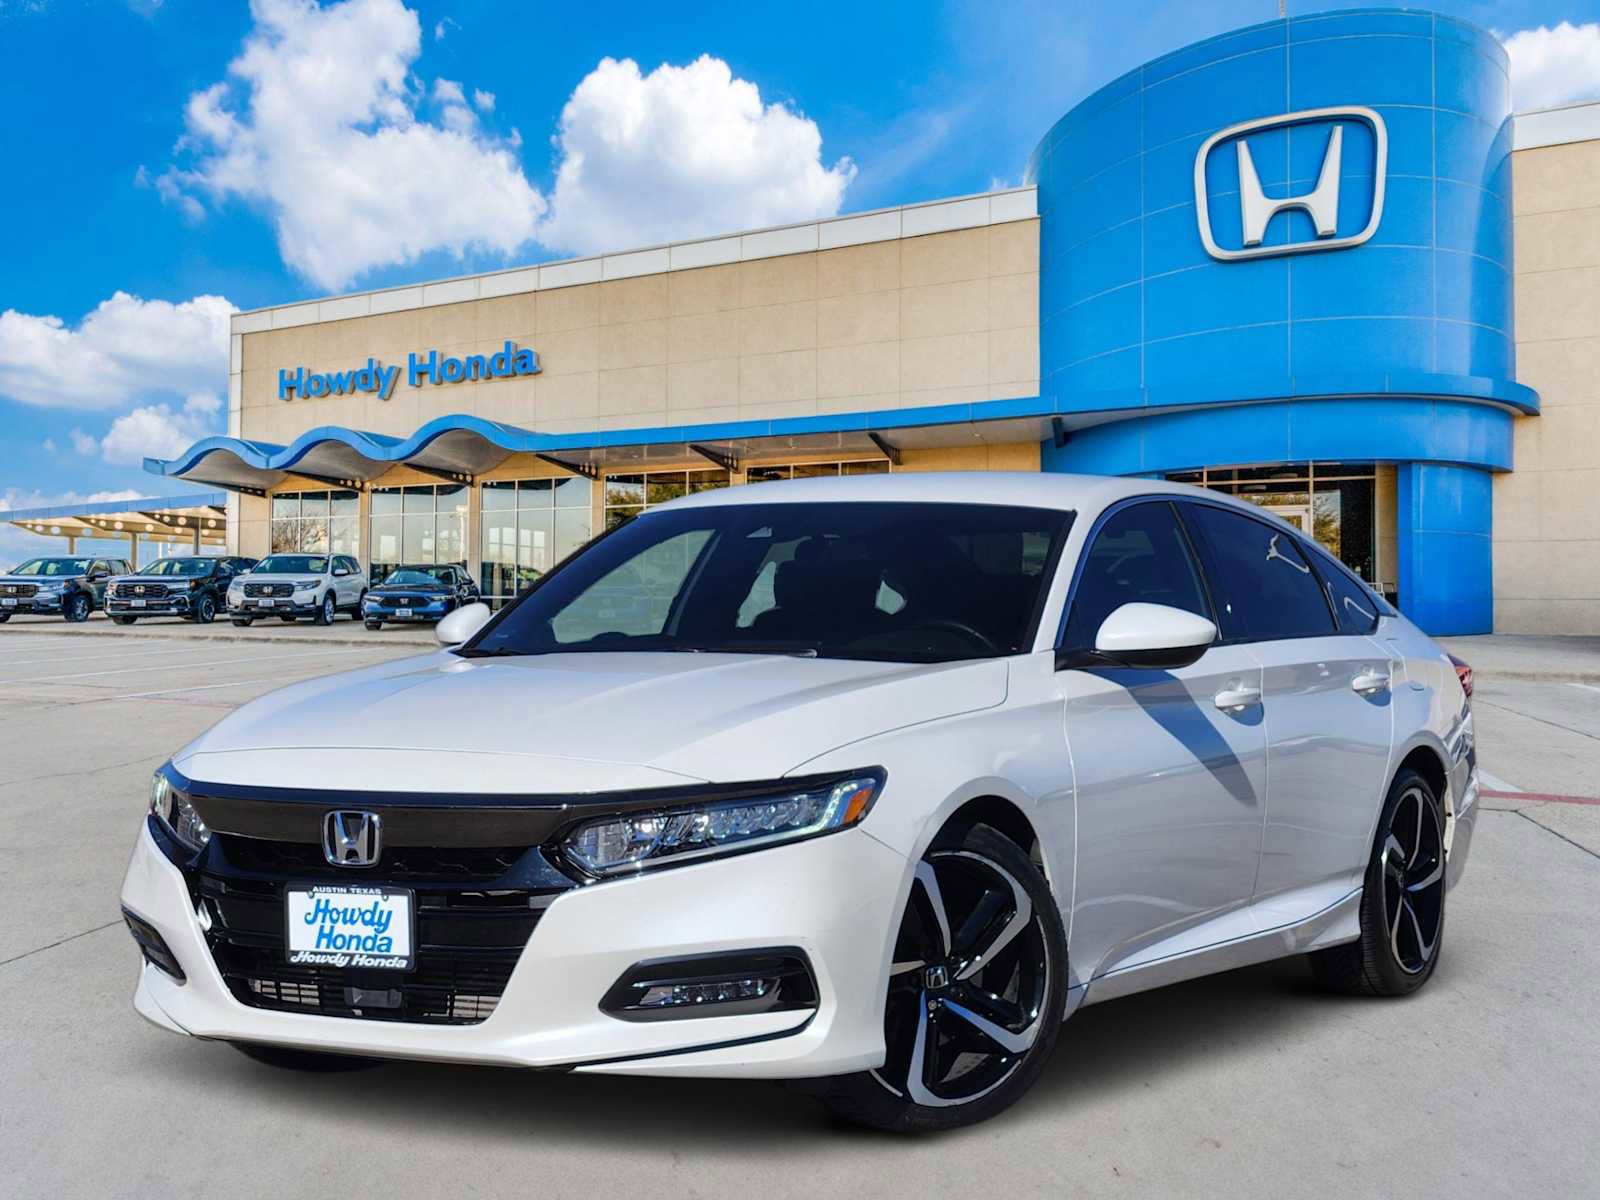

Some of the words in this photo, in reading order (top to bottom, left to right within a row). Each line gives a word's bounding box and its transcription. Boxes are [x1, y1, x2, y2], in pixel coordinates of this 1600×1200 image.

[278, 358, 400, 400] Howdy
[407, 341, 541, 387] Honda
[312, 885, 347, 894] AUSTIN
[350, 887, 382, 895] TEXAS
[304, 898, 393, 934] Howdy
[315, 925, 393, 952] Honda
[290, 951, 350, 967] Howdy
[351, 953, 408, 968] Honda
